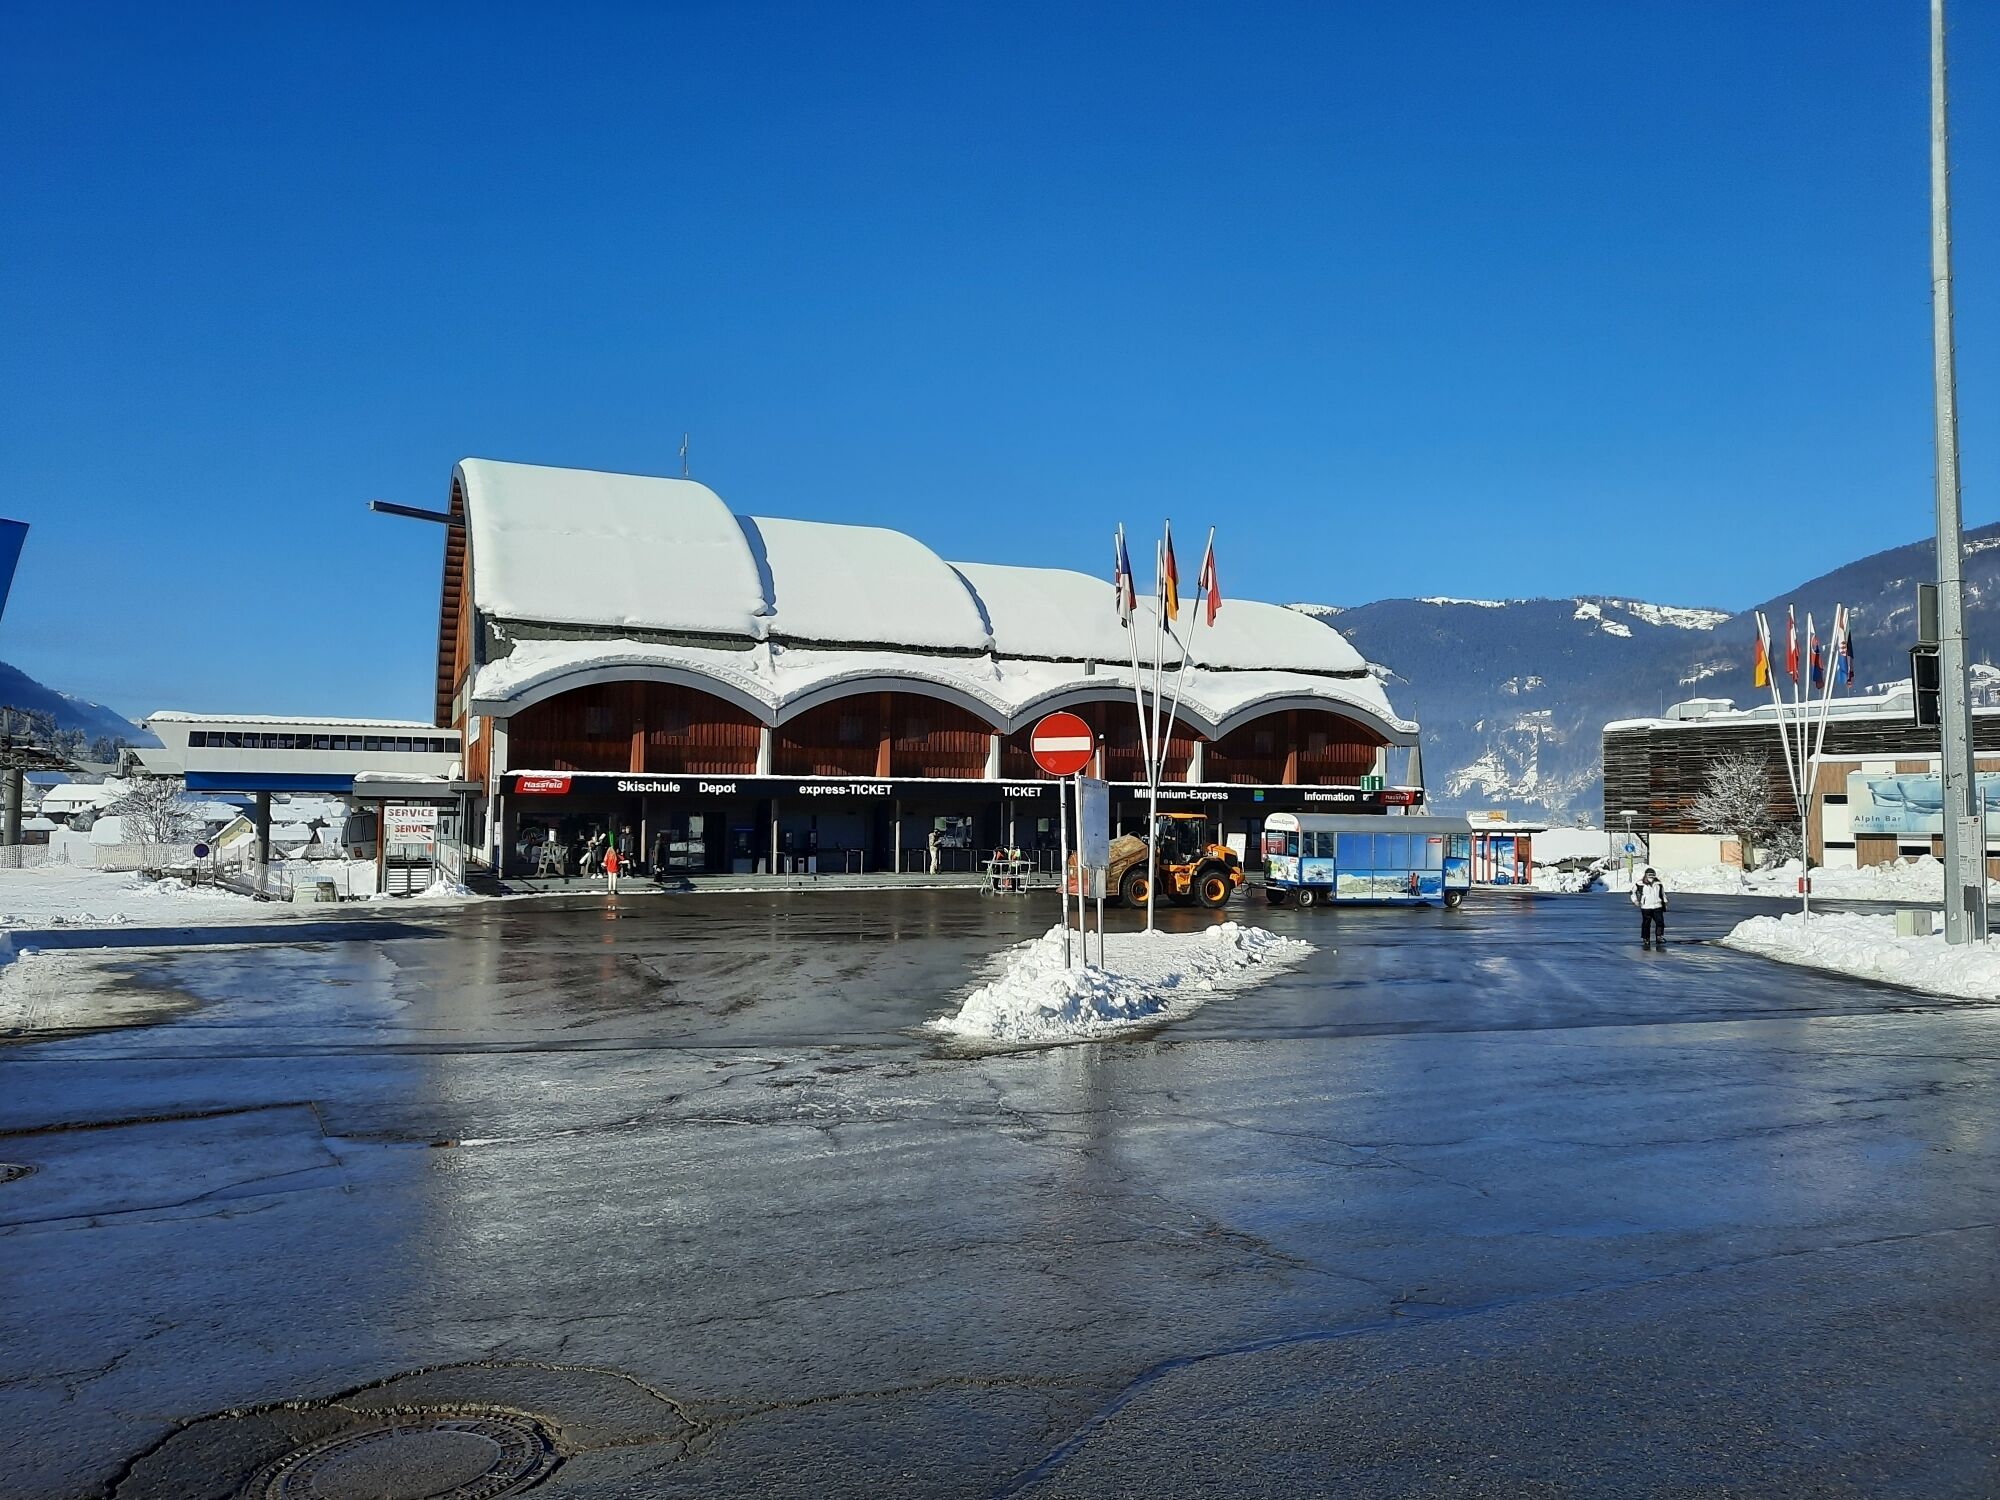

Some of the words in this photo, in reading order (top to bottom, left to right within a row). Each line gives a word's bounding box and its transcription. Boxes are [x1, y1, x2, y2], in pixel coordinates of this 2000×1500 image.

[617, 781, 680, 792] Skischule
[699, 782, 736, 795] Depot
[799, 785, 892, 795] express-TICKET
[1003, 787, 1042, 797] TICKET
[1134, 789, 1229, 801] Millnnium-Express
[1304, 792, 1355, 801] Information
[388, 808, 434, 817] SERVICE
